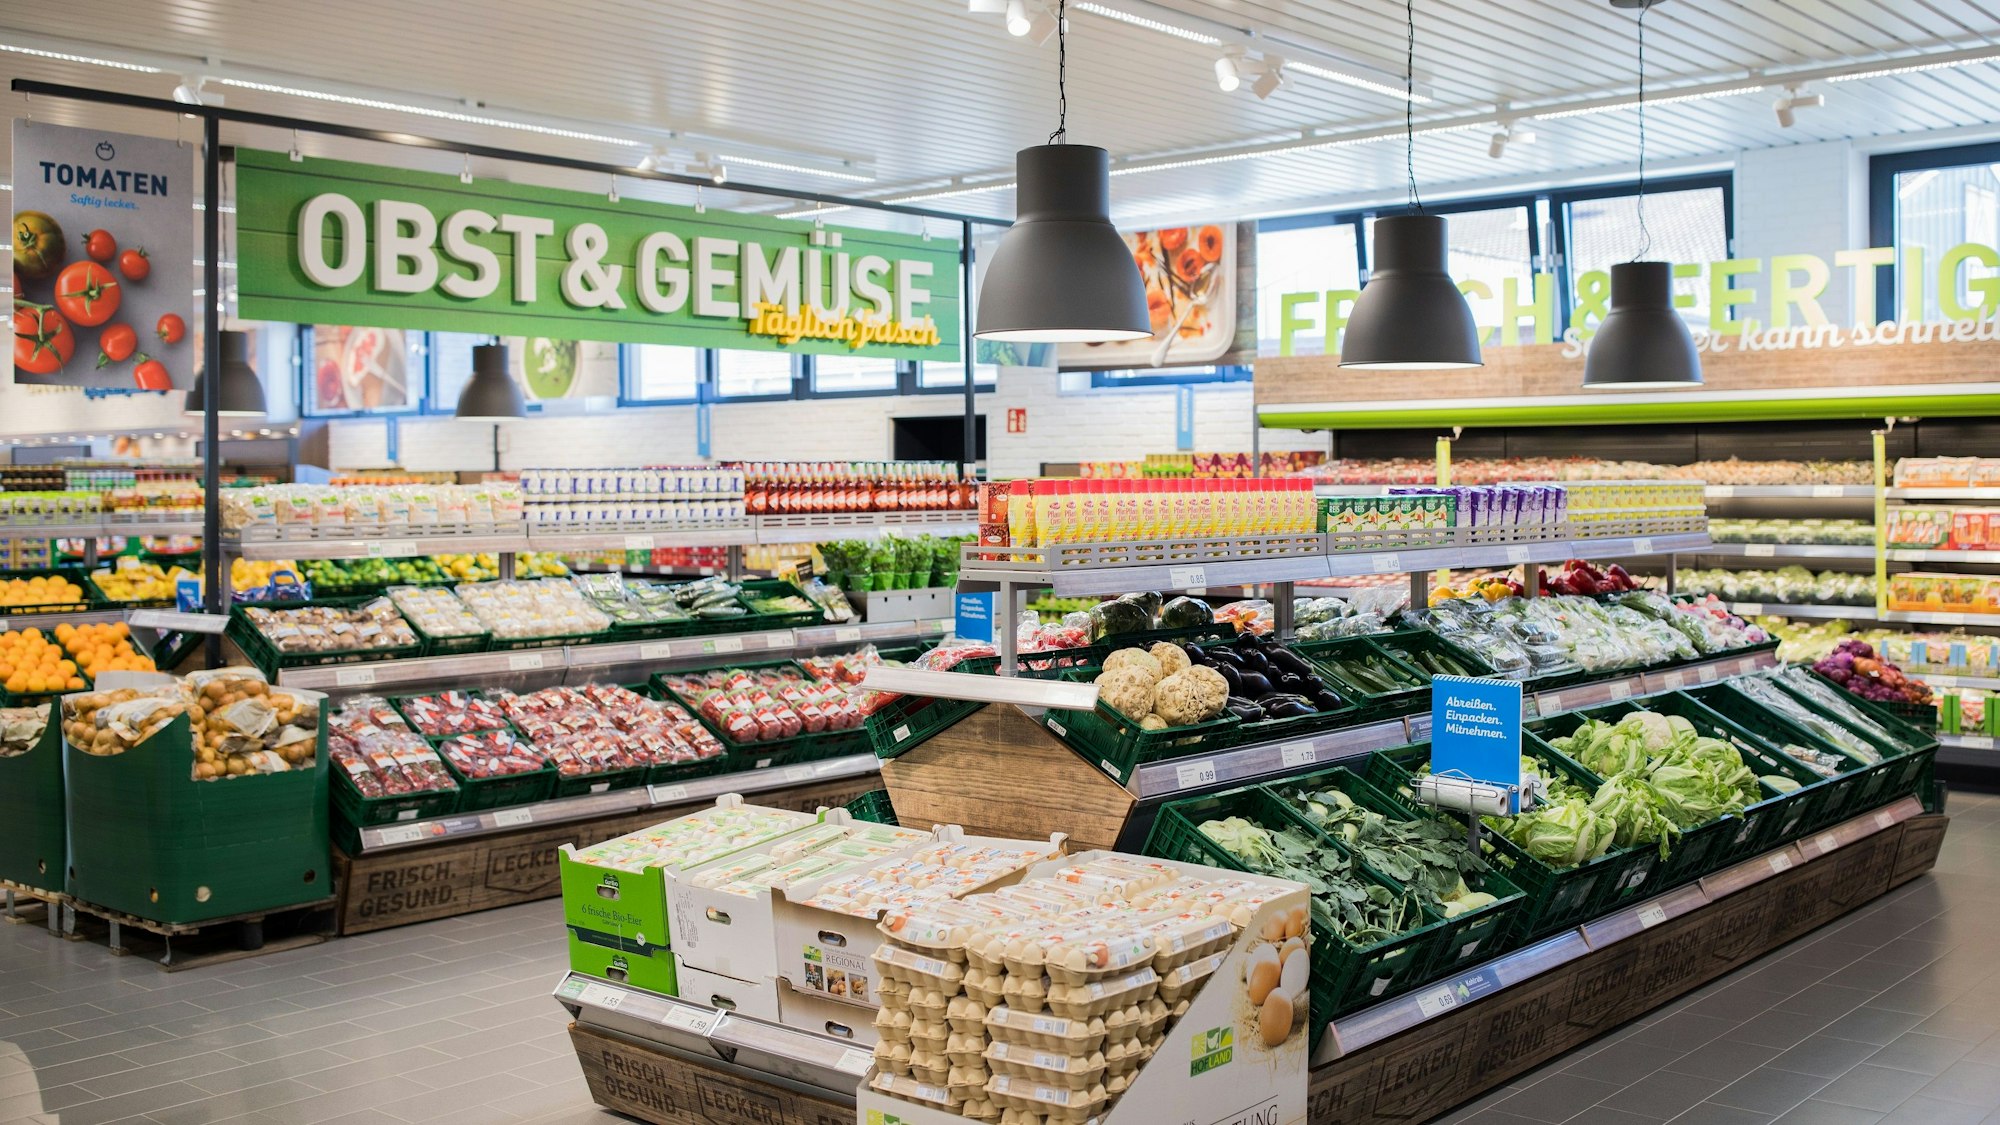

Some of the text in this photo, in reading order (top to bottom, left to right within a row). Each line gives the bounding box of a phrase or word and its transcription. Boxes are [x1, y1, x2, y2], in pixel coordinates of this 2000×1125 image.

[39, 161, 168, 197] TOMATEN
[70, 193, 101, 208] Saftig
[297, 192, 934, 330] OBST & GEMÜSE
[1569, 270, 1612, 339] &
[750, 302, 941, 348] Täglich frisch
[1738, 317, 1846, 352] kann
[1190, 575, 1204, 584] 0.85
[1446, 696, 1497, 711] Abreißen.
[1446, 710, 1503, 726] Einpacken.
[1446, 723, 1507, 740] Mitnehmen.
[1301, 752, 1314, 761] 1.79
[1200, 771, 1214, 782] 0.99
[367, 861, 456, 893] FRISCH.
[359, 885, 459, 918] GESUND.
[581, 903, 642, 927] 6 frische Bio-Eier
[825, 954, 866, 970] REGIONAL
[1652, 929, 1701, 967] FRISCH.
[1573, 963, 1631, 1006] LECKER.
[1643, 955, 1697, 997] GESUND.
[602, 996, 619, 1007] 1.55
[1438, 994, 1454, 1007] 0.69
[688, 1019, 707, 1030] 1.59
[1489, 993, 1551, 1042] FRISCH.
[1191, 1050, 1232, 1074] HOFLAND
[1477, 1023, 1546, 1077] GESUND.
[602, 1050, 673, 1089] FRISCH.
[1381, 1042, 1457, 1095] LECKER.
[604, 1075, 683, 1116] GESUND.
[701, 1086, 781, 1125] LECKER.
